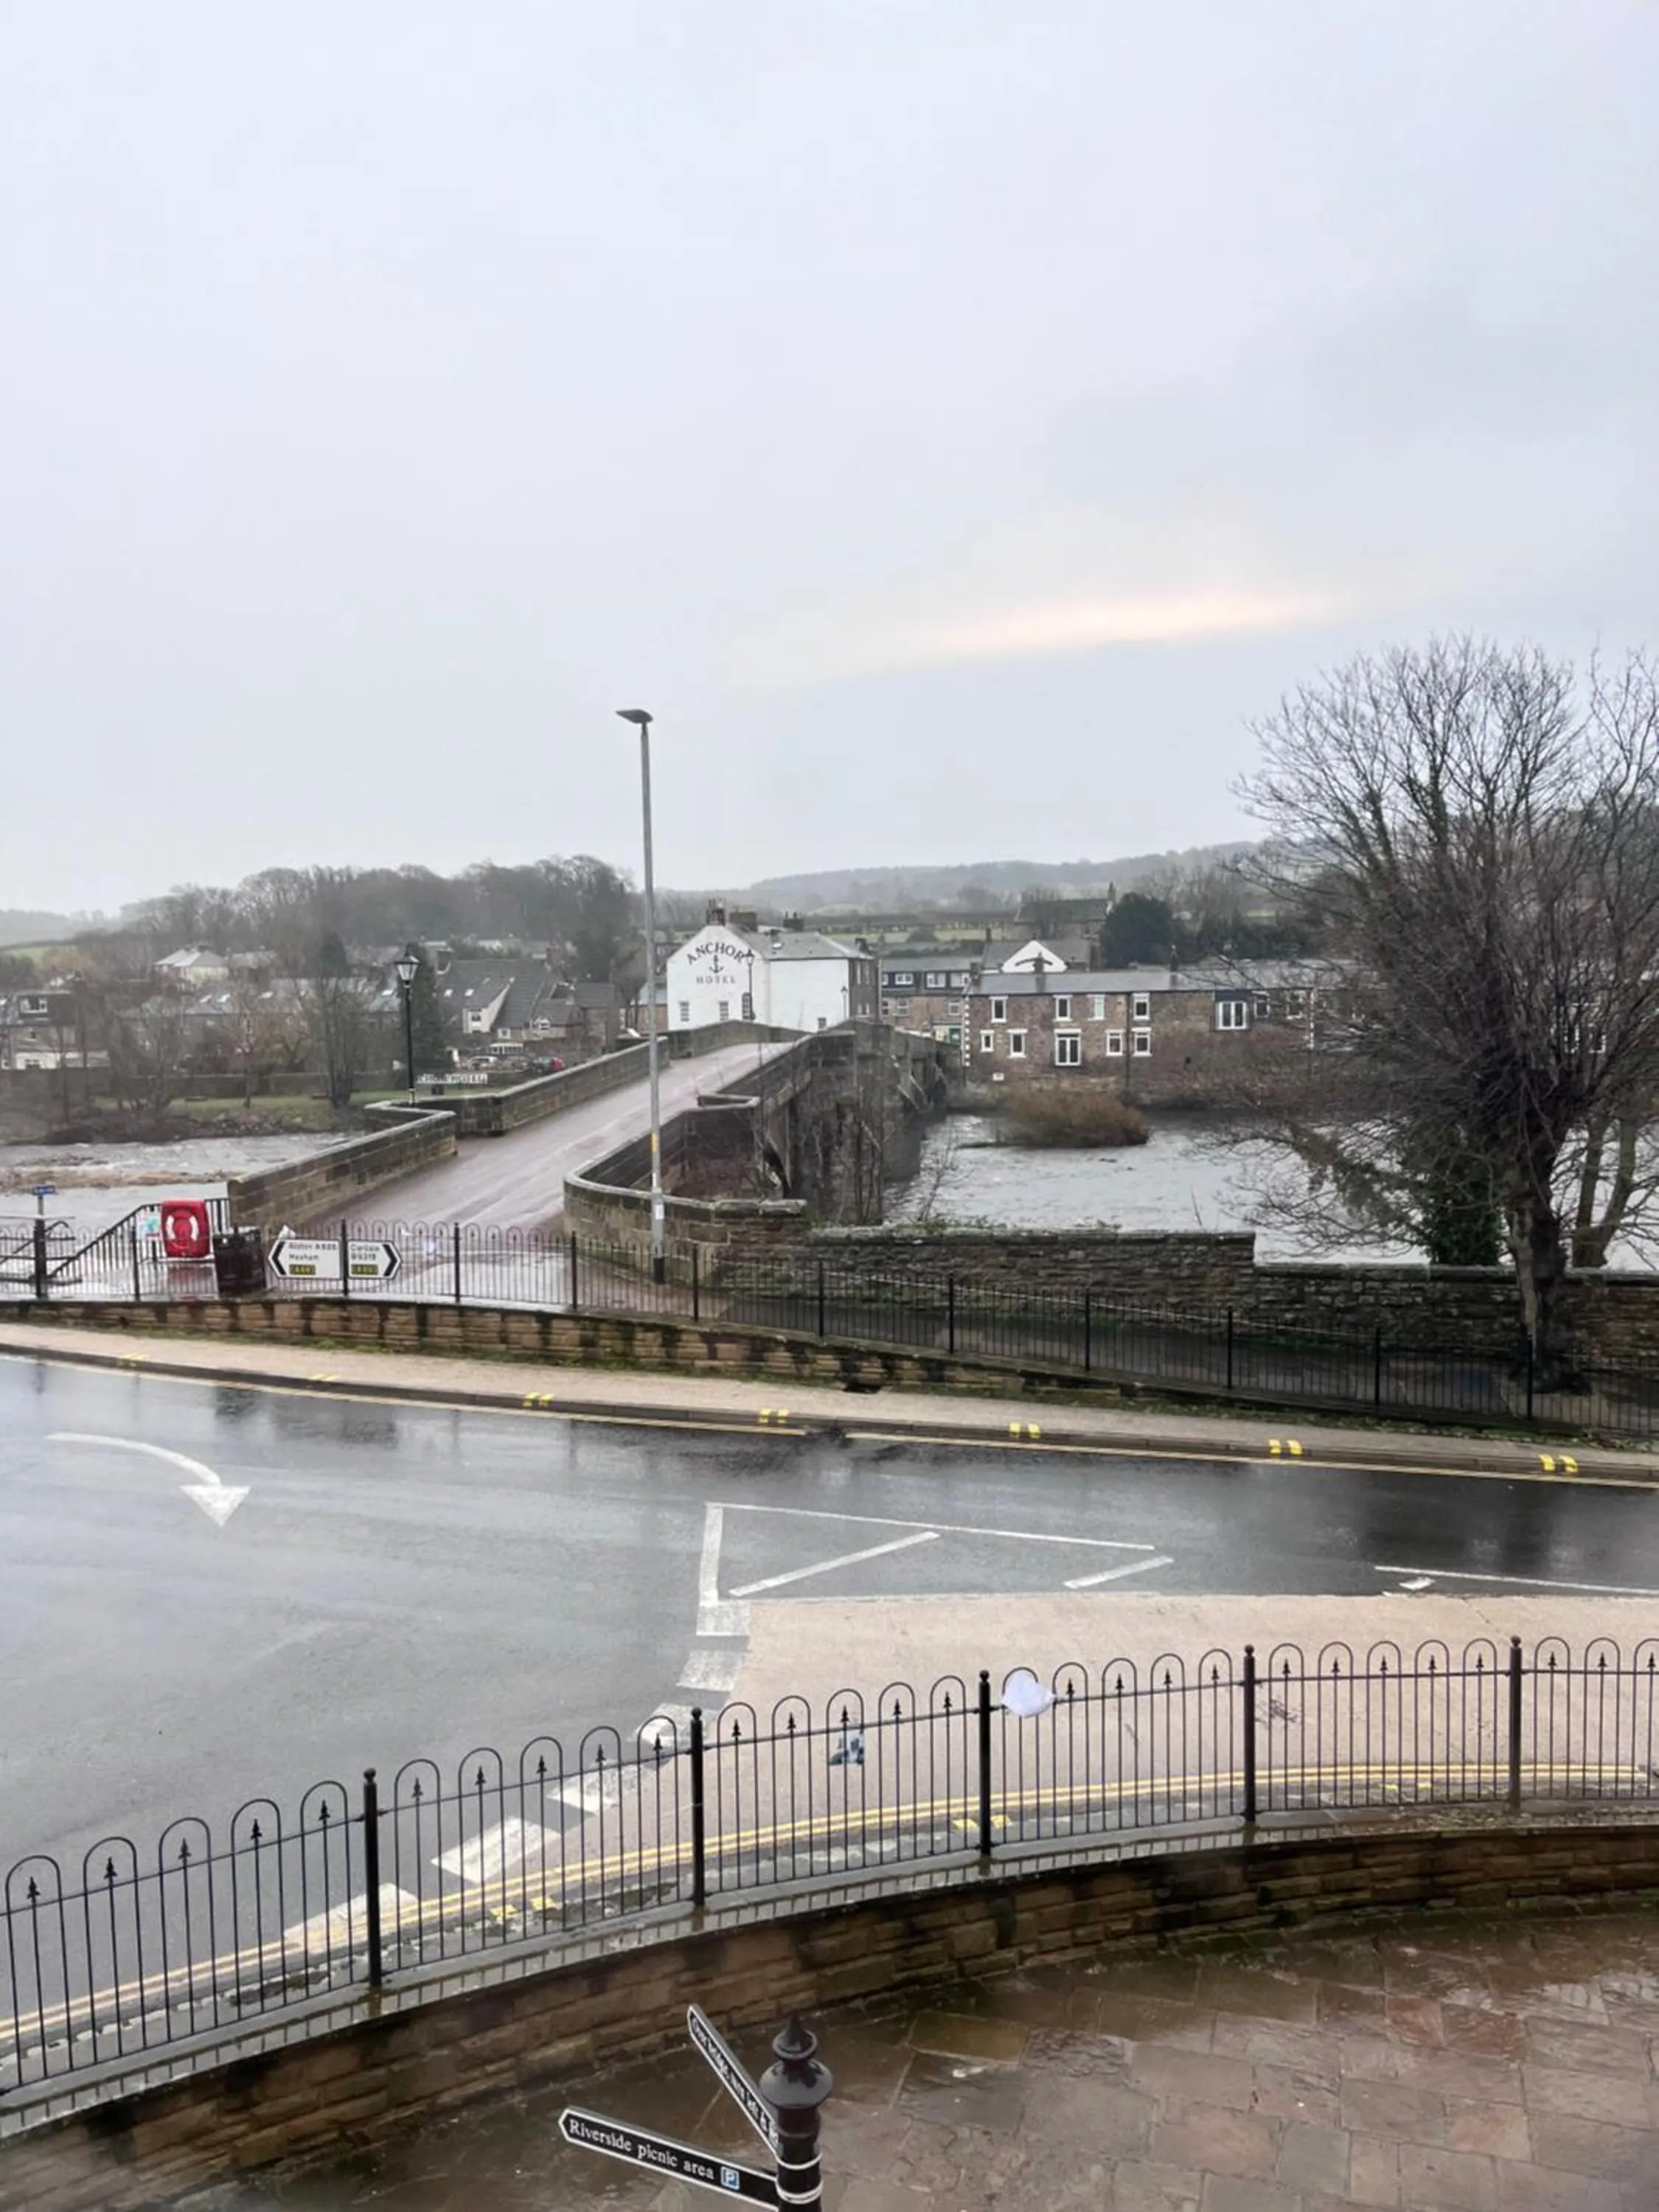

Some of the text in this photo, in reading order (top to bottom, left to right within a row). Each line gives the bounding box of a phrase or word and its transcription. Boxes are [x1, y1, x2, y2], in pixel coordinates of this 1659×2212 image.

[686, 942, 745, 964] ANCHOR
[695, 975, 737, 984] HOTEL
[569, 2119, 632, 2152] Riverside
[638, 2143, 678, 2166] picnic
[684, 2160, 714, 2180] area
